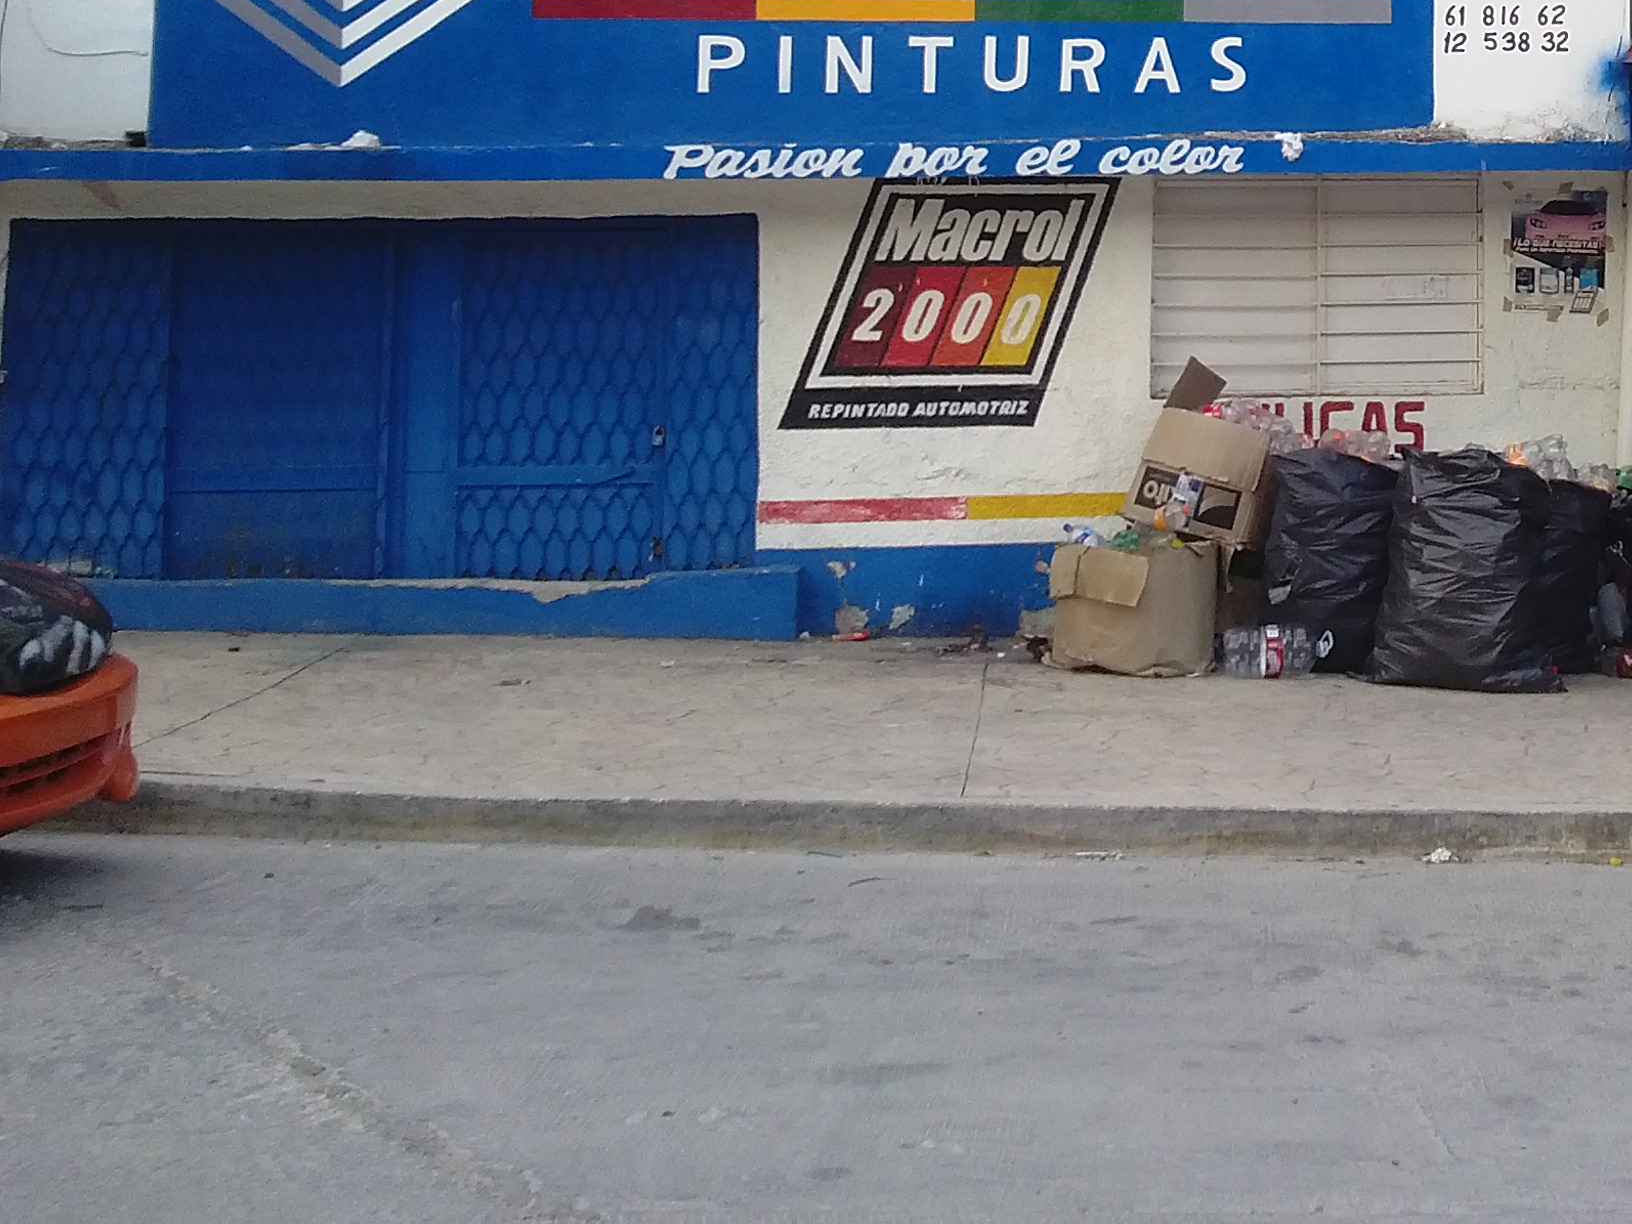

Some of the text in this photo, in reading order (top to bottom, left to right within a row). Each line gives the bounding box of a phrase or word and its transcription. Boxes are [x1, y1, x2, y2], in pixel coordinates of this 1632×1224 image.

[1445, 4, 1566, 26] 61 816 62
[1444, 31, 1569, 53] 12 538 32
[696, 34, 1249, 94] PINTURAS
[663, 137, 1246, 180] Pasion por el color
[874, 198, 1087, 261] Macrol
[851, 287, 1043, 346] 2000
[808, 399, 1030, 419] REPINTADO AUTOMOTRIZ
